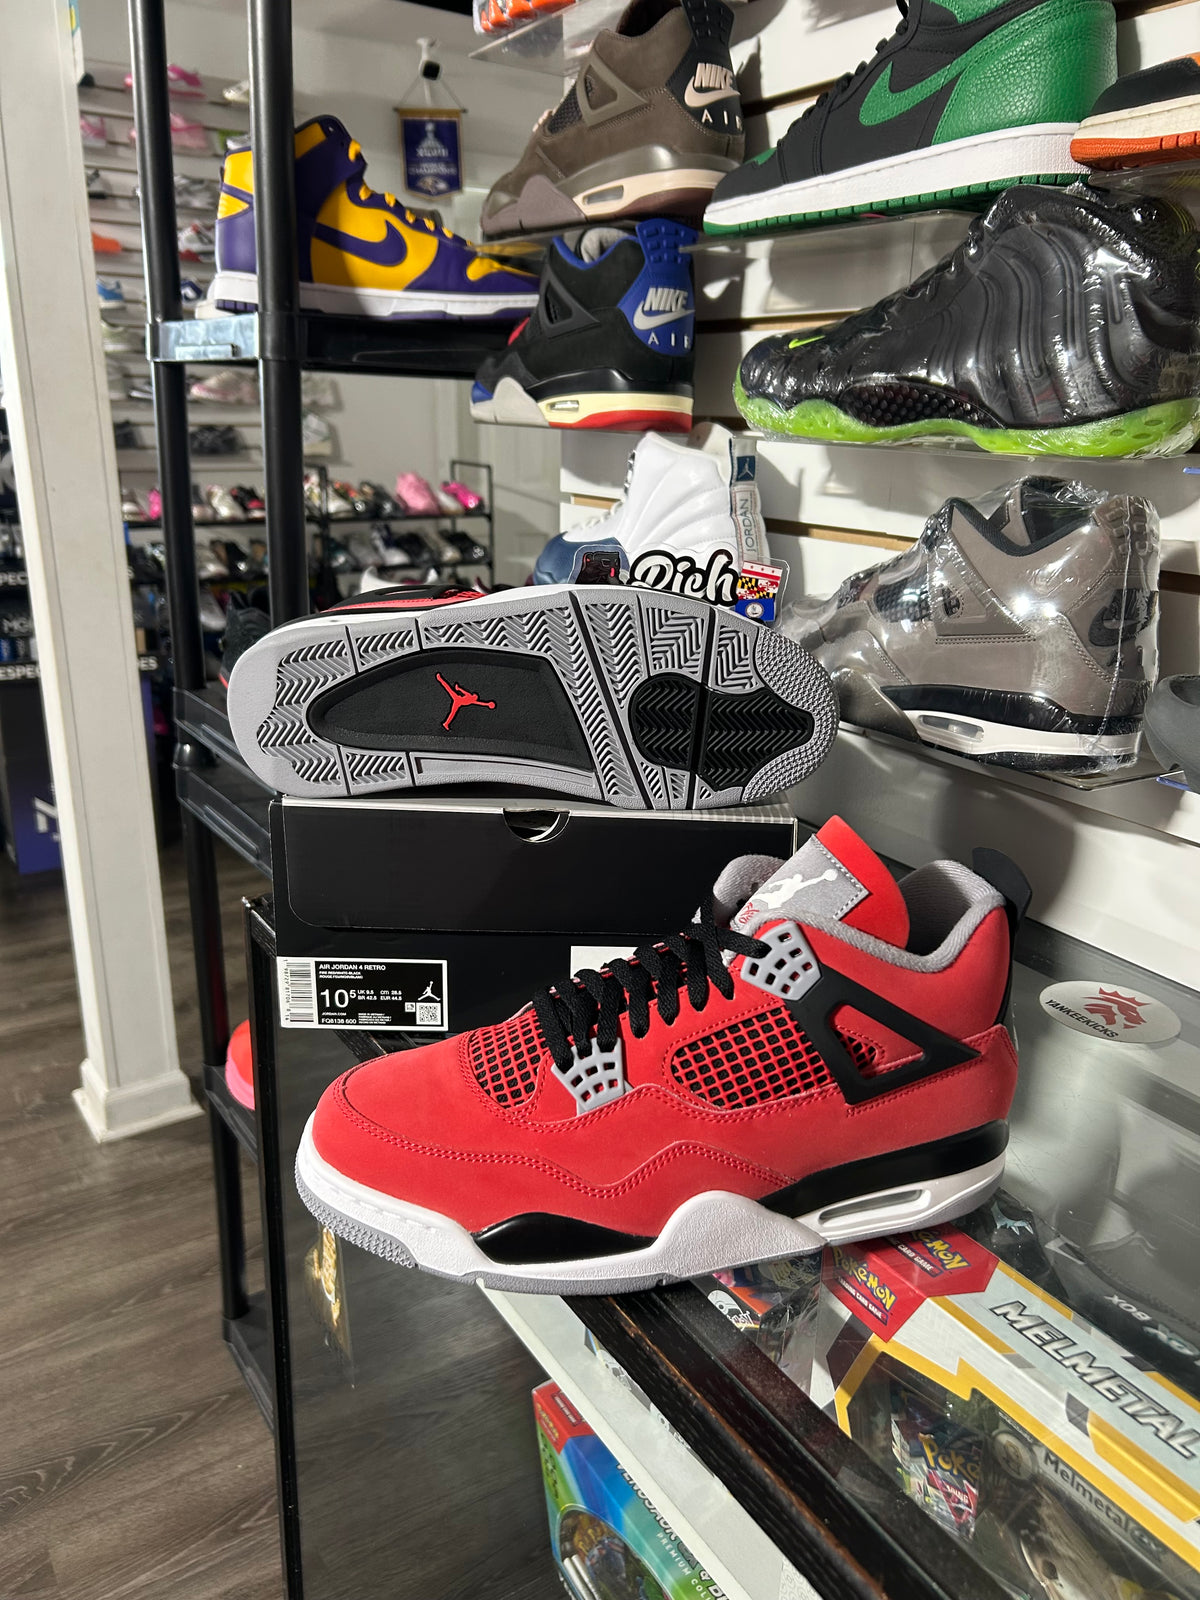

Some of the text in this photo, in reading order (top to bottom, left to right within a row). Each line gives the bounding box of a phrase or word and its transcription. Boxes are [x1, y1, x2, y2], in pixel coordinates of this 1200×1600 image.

[694, 62, 734, 91] NIKE
[643, 286, 688, 313] NIKE
[739, 498, 757, 553] JORDAN
[1045, 999, 1119, 1038] YANKEEKICKS
[1103, 1294, 1152, 1322] BOX
[989, 1300, 1200, 1461] MELMETAL
[1042, 1450, 1131, 1534] Melmetal
[656, 1531, 692, 1576] PREMIUM
